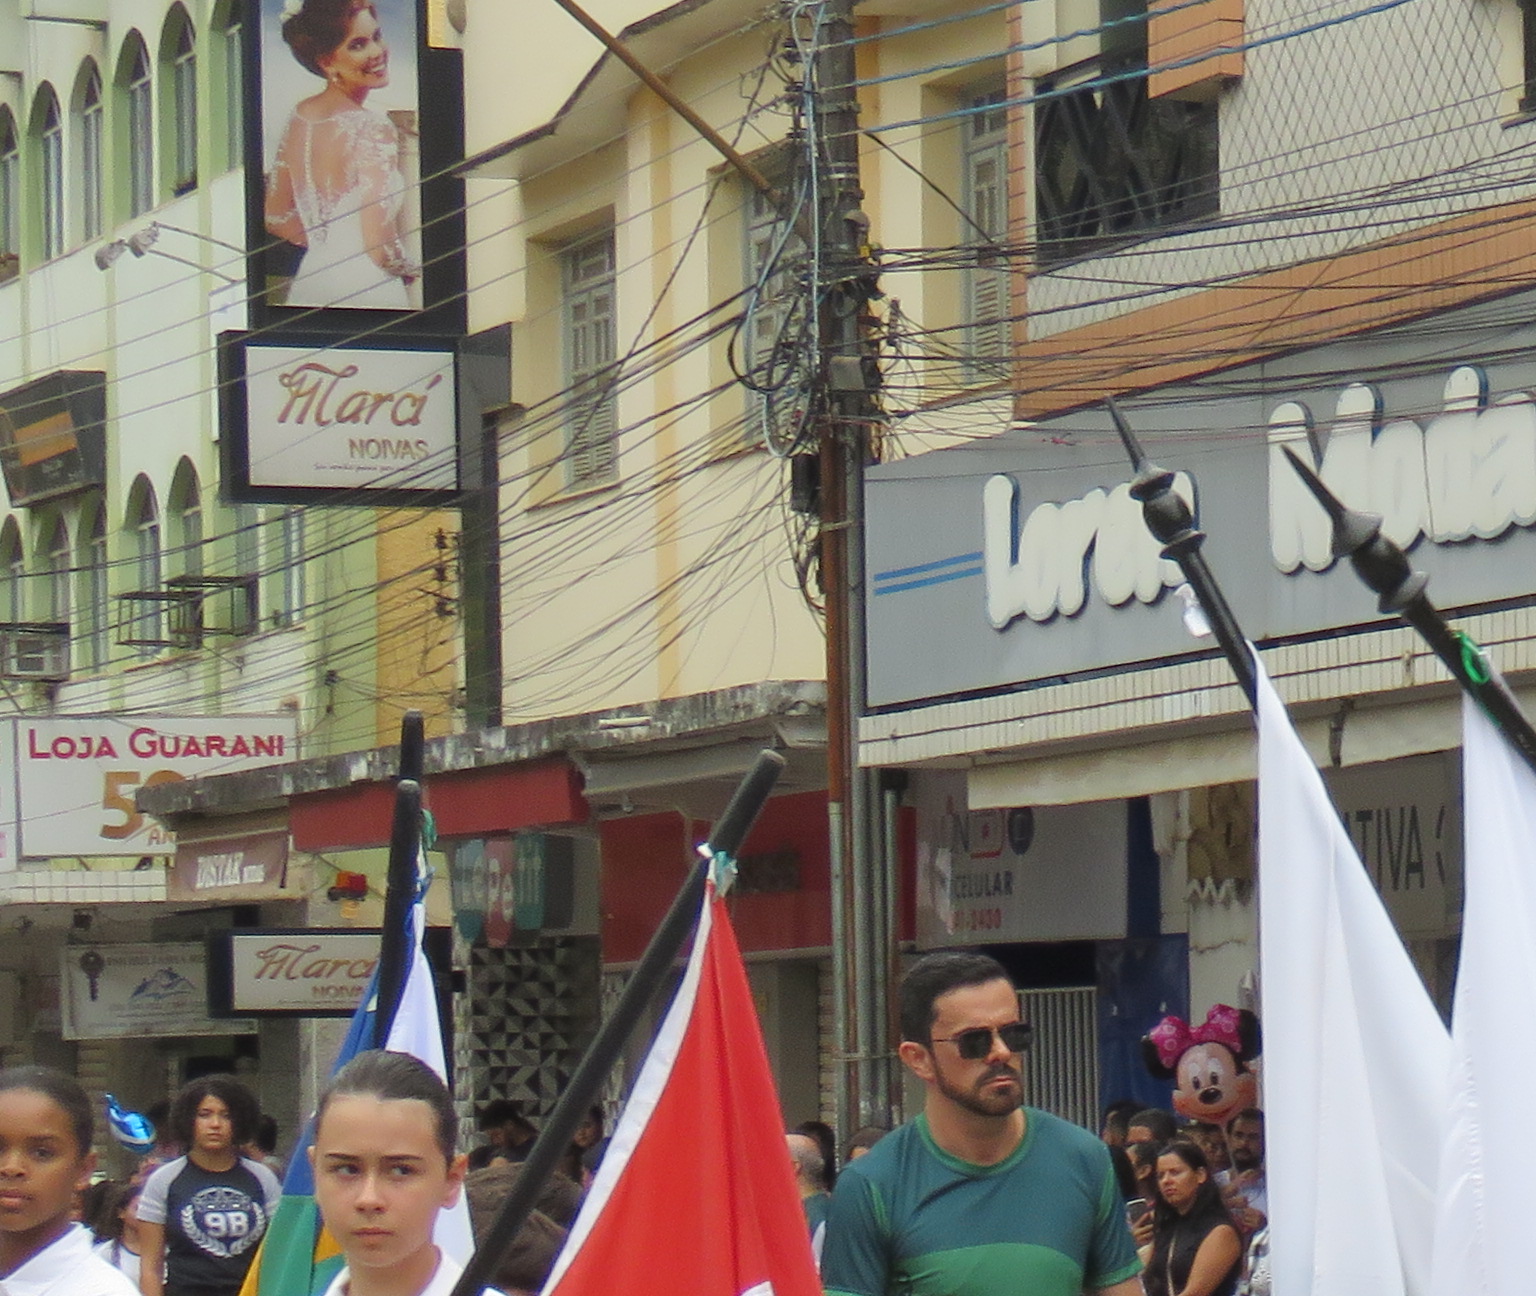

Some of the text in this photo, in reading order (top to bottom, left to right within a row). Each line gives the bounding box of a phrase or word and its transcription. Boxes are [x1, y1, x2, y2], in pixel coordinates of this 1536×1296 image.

[348, 438, 429, 460] NOIVAS
[29, 727, 285, 760] LOJA GUARANI
